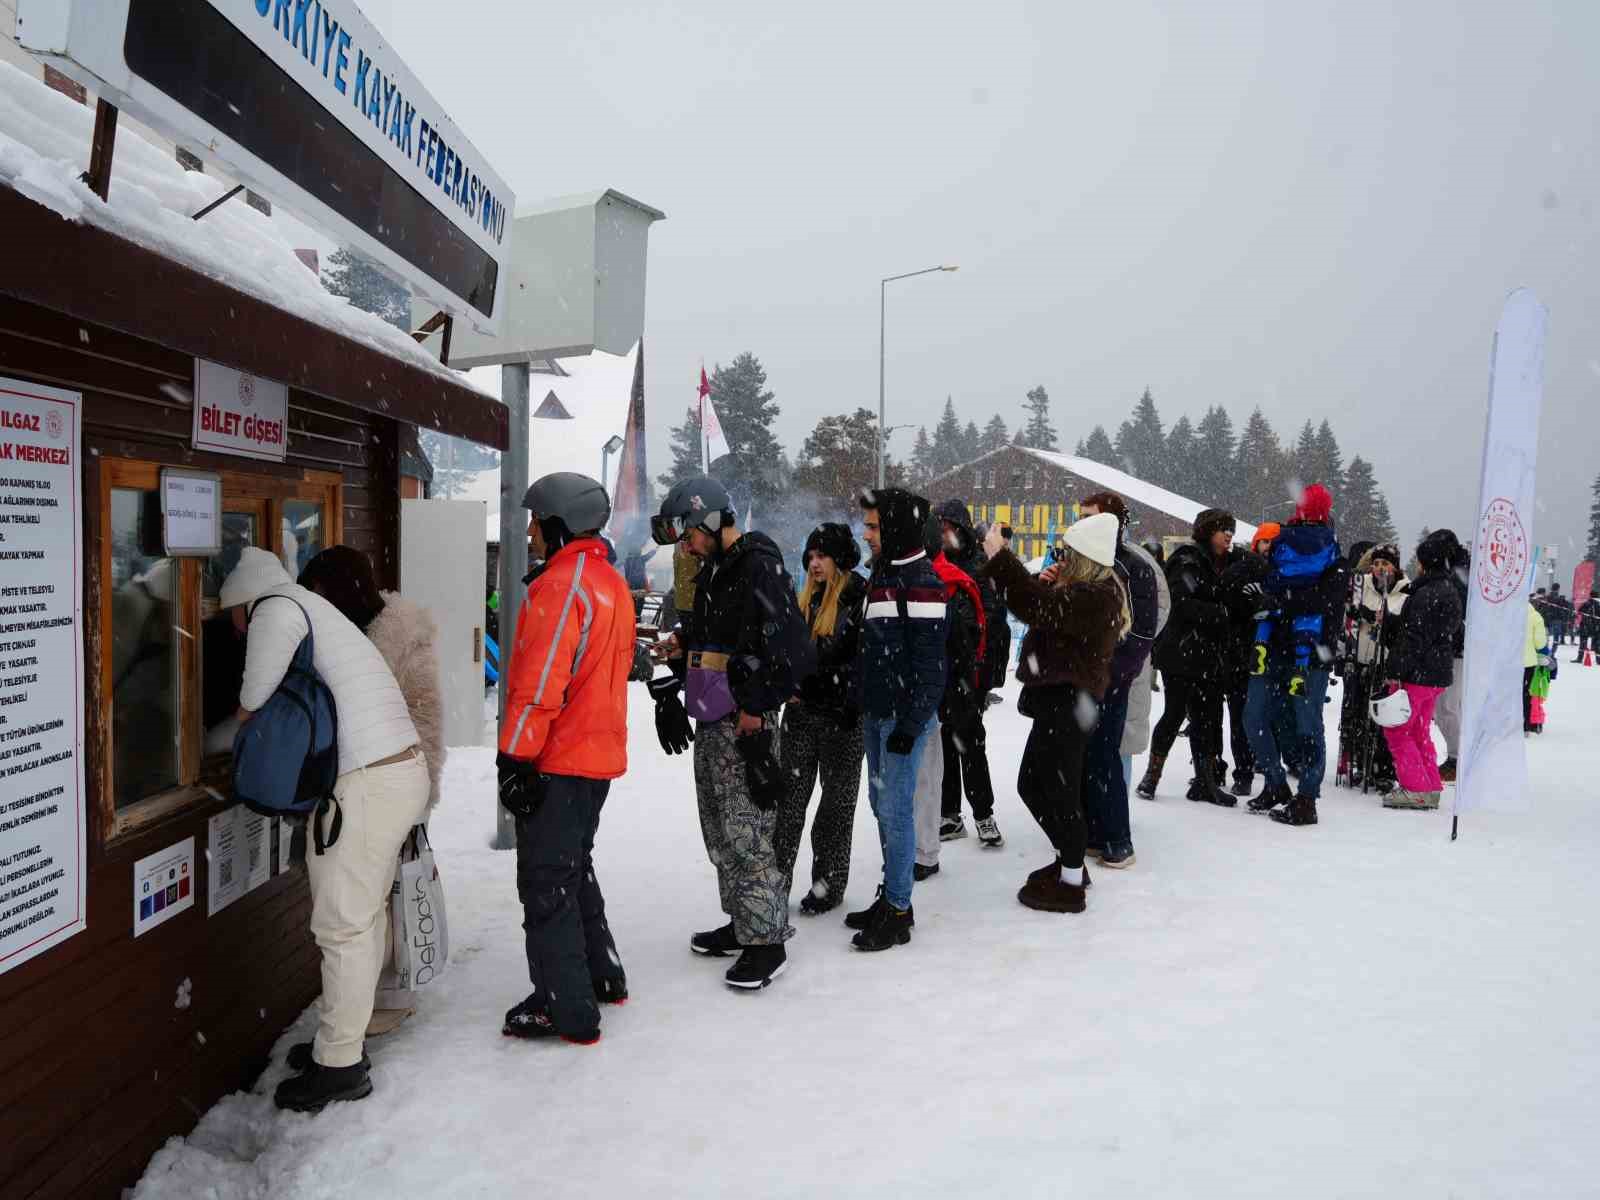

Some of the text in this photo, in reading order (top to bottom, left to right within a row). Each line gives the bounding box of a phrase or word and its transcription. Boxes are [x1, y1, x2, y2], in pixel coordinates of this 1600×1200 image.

[353, 49, 417, 160] KAYAK
[417, 118, 506, 245] FEDERASYONU
[1, 410, 41, 432] ILGAZ
[200, 403, 283, 446] BİLET GİŞESİ
[15, 444, 69, 466] MERKEZİ
[20, 585, 27, 596] VE
